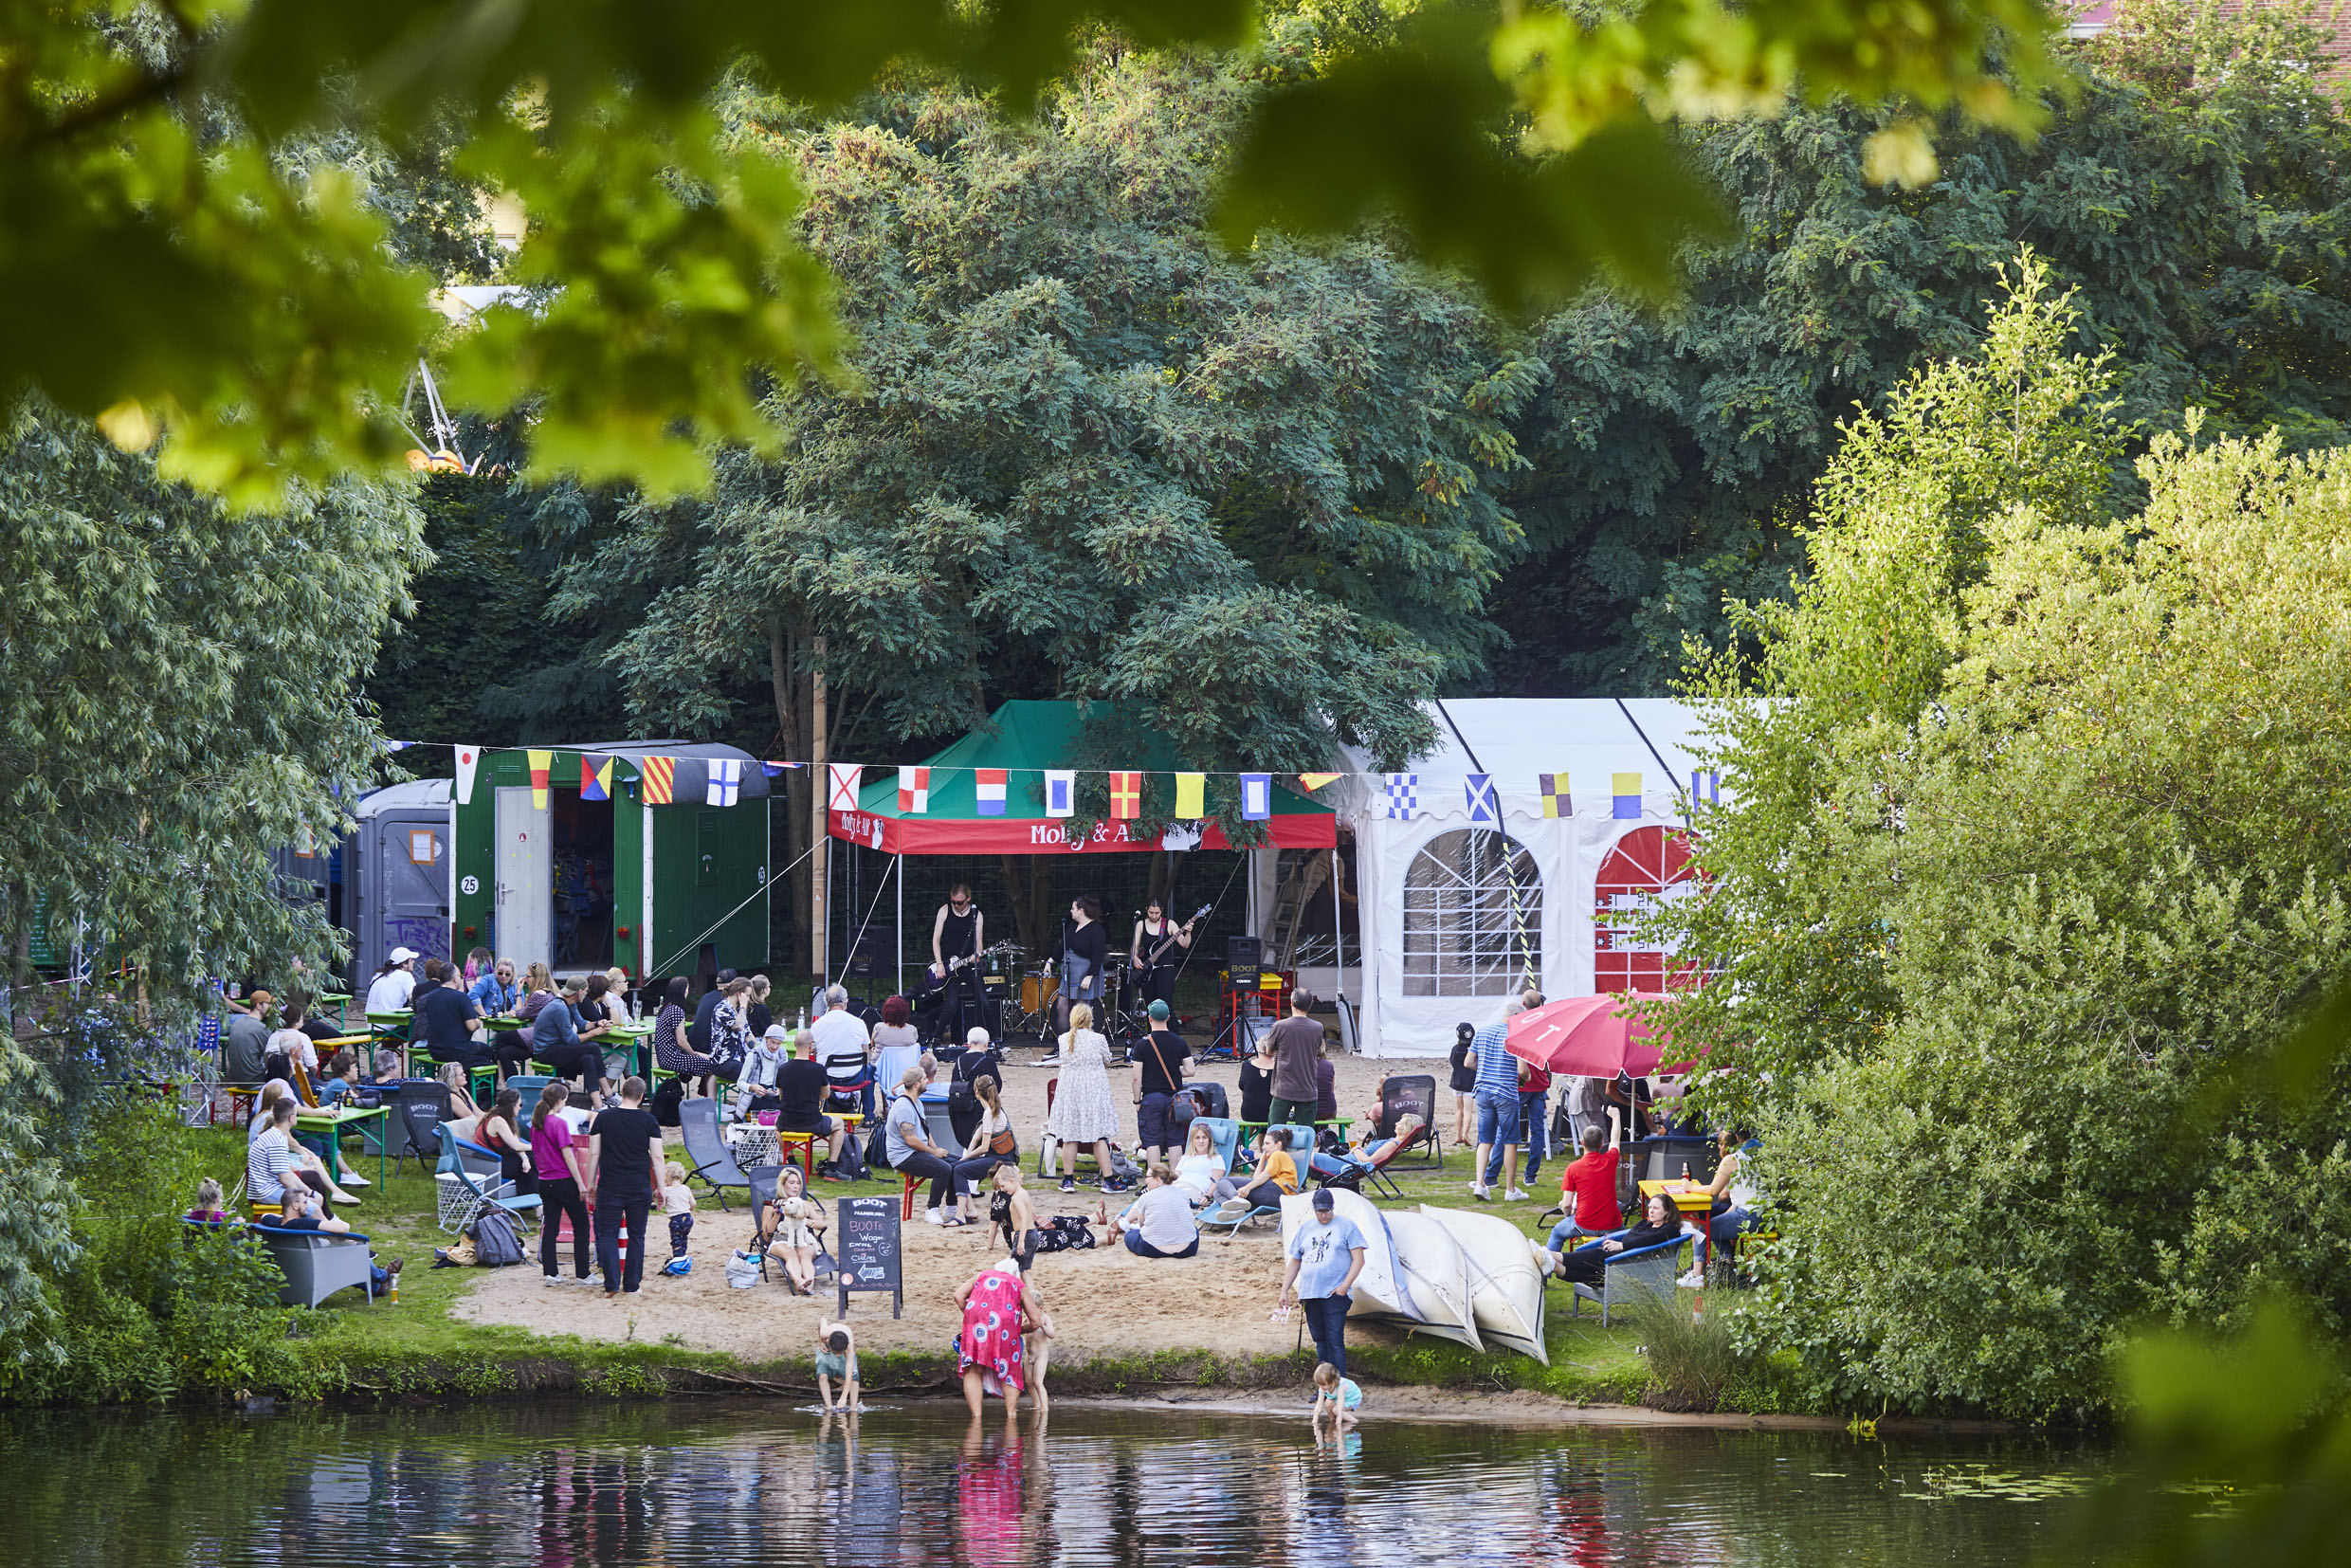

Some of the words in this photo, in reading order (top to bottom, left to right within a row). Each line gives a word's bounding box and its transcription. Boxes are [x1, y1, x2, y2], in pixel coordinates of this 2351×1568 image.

[842, 811, 856, 840] Molly
[856, 814, 862, 833] &
[1092, 823, 1109, 842] &
[465, 879, 476, 891] 25
[410, 1103, 439, 1112] BOOT
[1394, 1100, 1425, 1109] BOOT
[852, 1198, 887, 1208] BOOT
[849, 1220, 884, 1232] BOOTs
